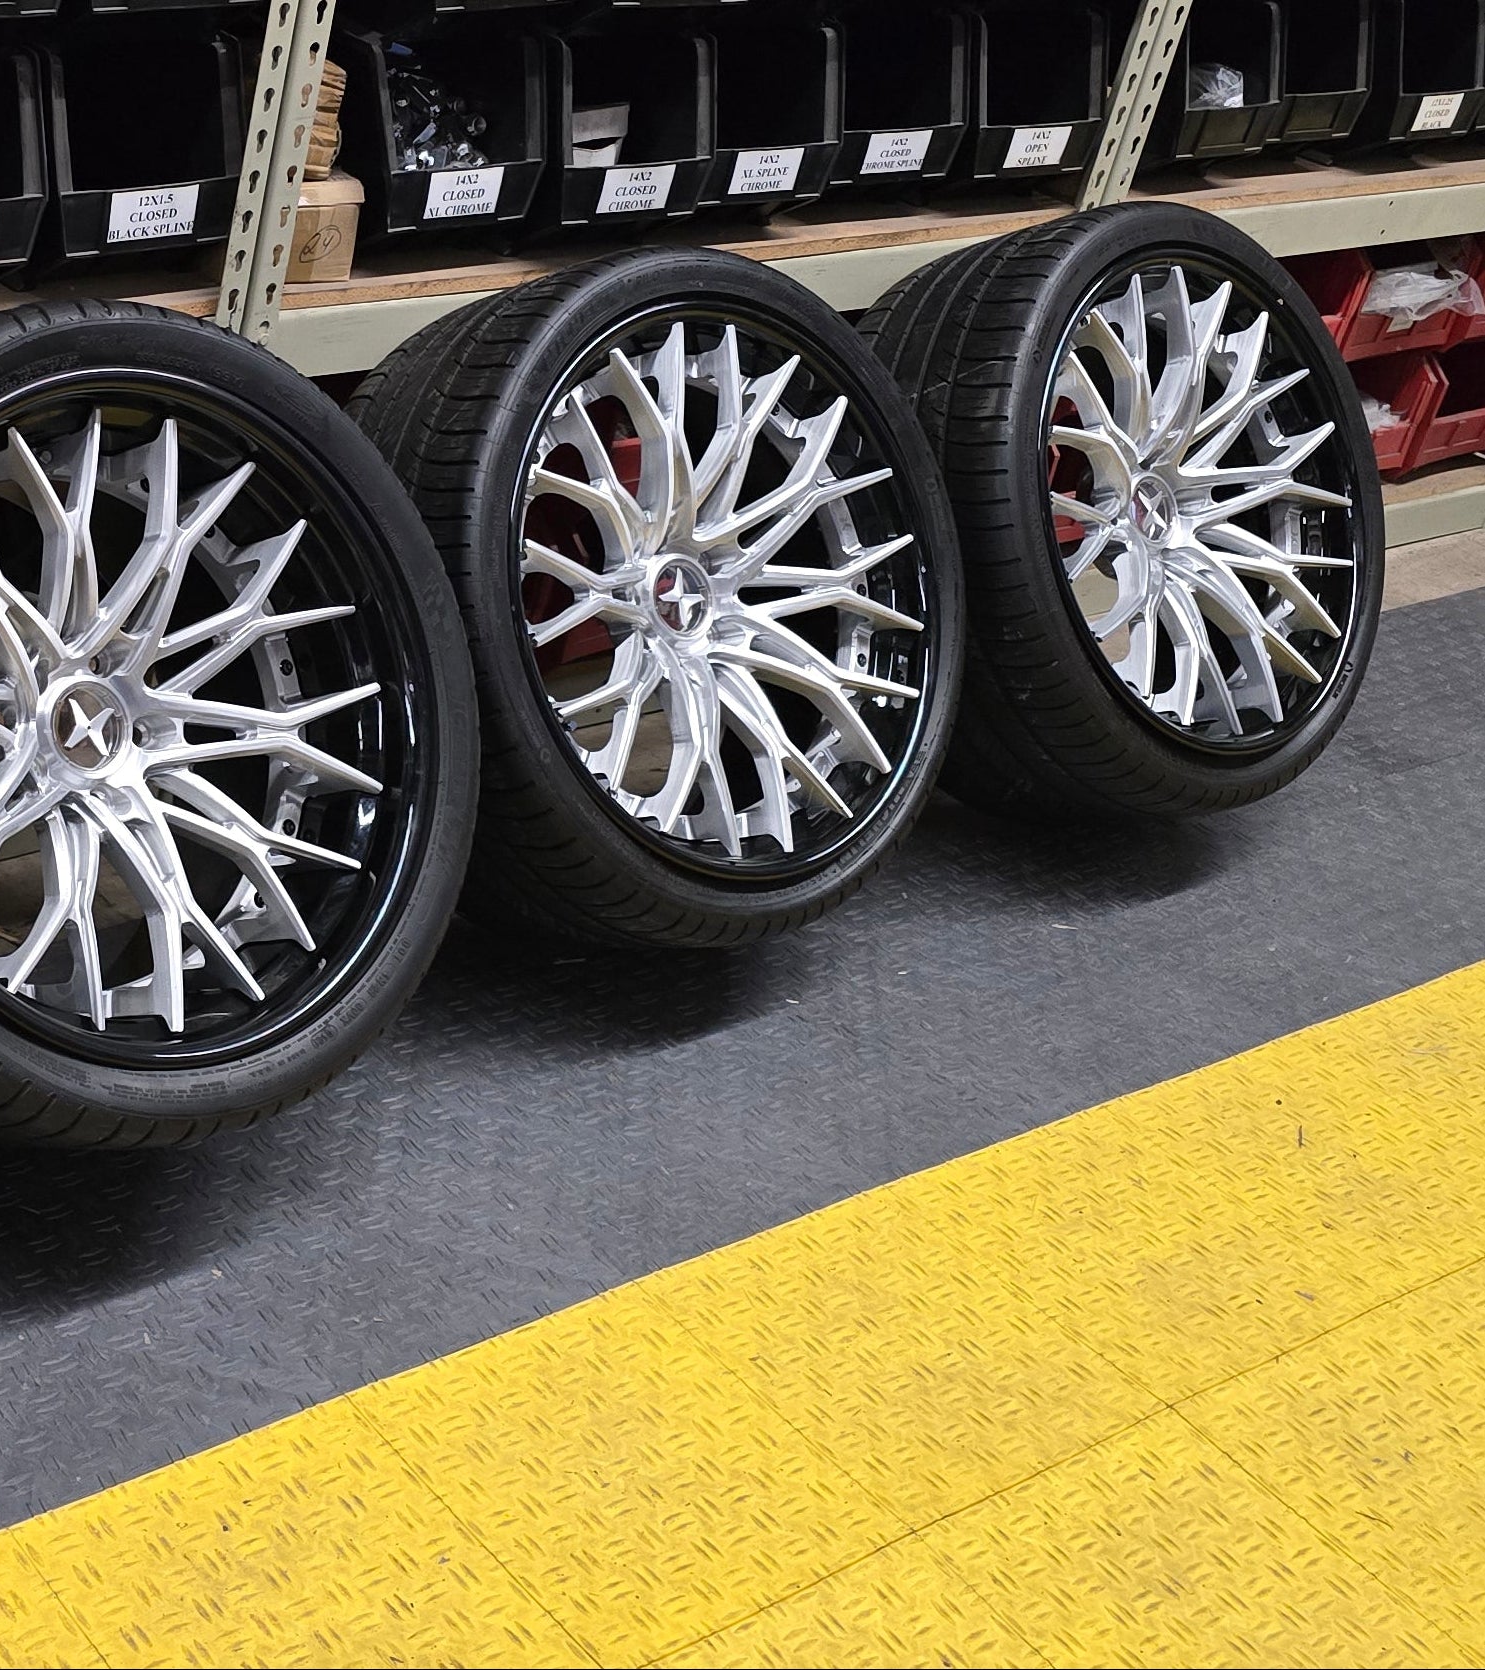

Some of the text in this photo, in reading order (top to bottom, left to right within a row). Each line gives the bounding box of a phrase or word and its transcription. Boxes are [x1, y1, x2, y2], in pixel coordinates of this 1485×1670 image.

[880, 148, 912, 158] CLOSED
[1024, 143, 1050, 153] OPEN
[865, 160, 896, 170] HROME
[629, 171, 653, 182] 14X2
[756, 167, 789, 178] SPLINE
[456, 174, 479, 185] 14X2
[615, 185, 657, 197] CLOSED
[740, 180, 783, 191] CHROME
[139, 193, 174, 207] 12X1.5
[442, 188, 485, 201] CLOSED
[444, 202, 492, 215] CHROME
[608, 199, 656, 211] CHROME
[129, 208, 178, 222] CLOSED
[108, 226, 150, 240] BLACK
